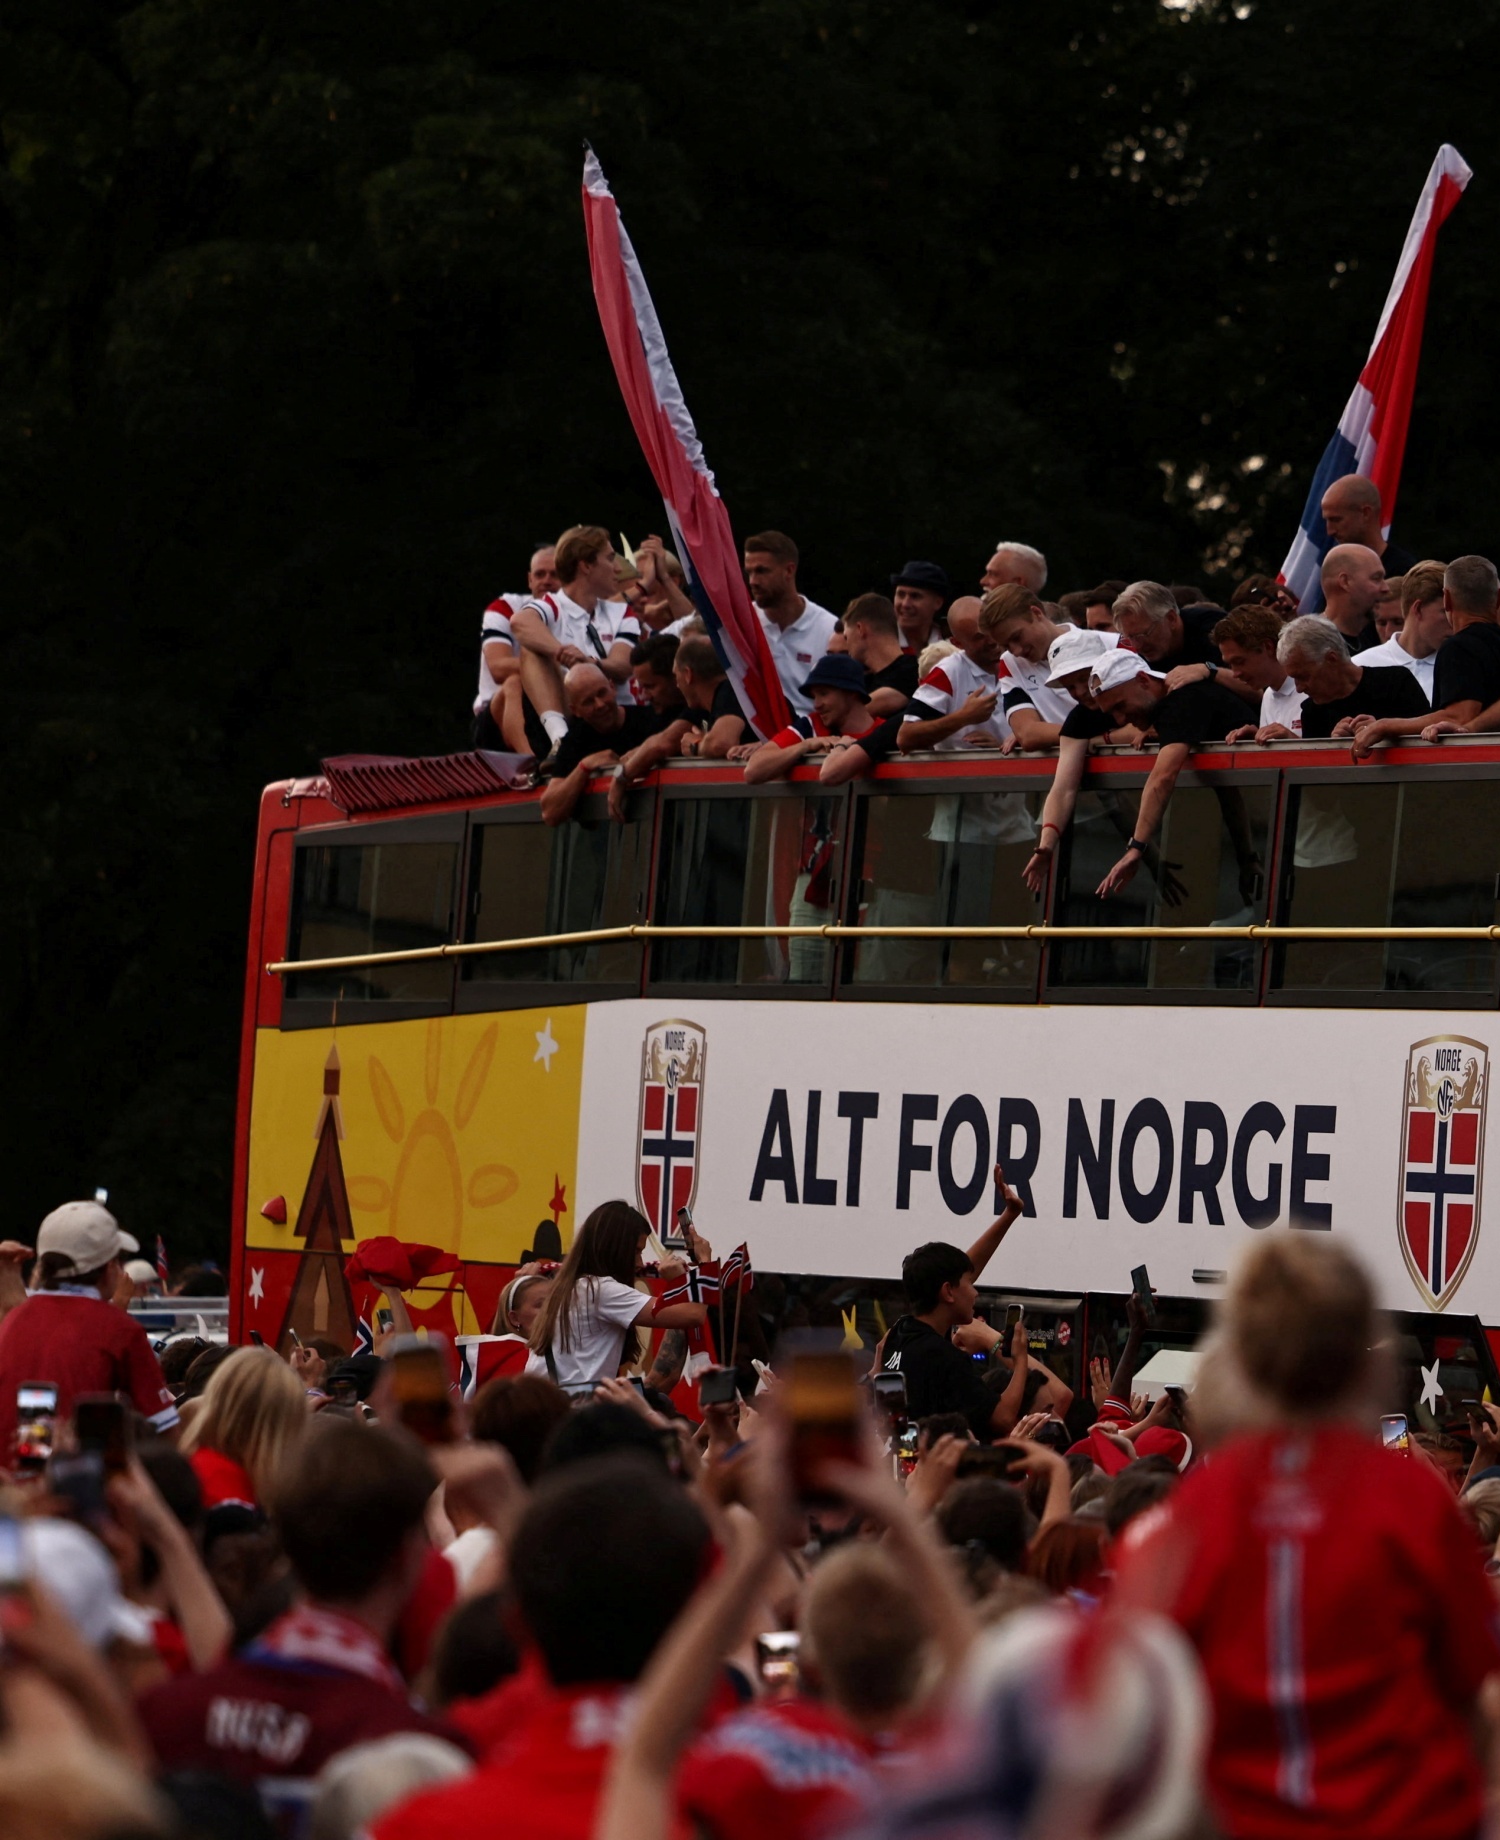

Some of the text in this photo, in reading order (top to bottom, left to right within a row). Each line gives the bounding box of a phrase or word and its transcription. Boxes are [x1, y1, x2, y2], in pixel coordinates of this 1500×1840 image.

[665, 1031, 686, 1051] NORGE
[1434, 1049, 1462, 1071] NORGE
[749, 1089, 1337, 1232] ALT FOR NORGE
